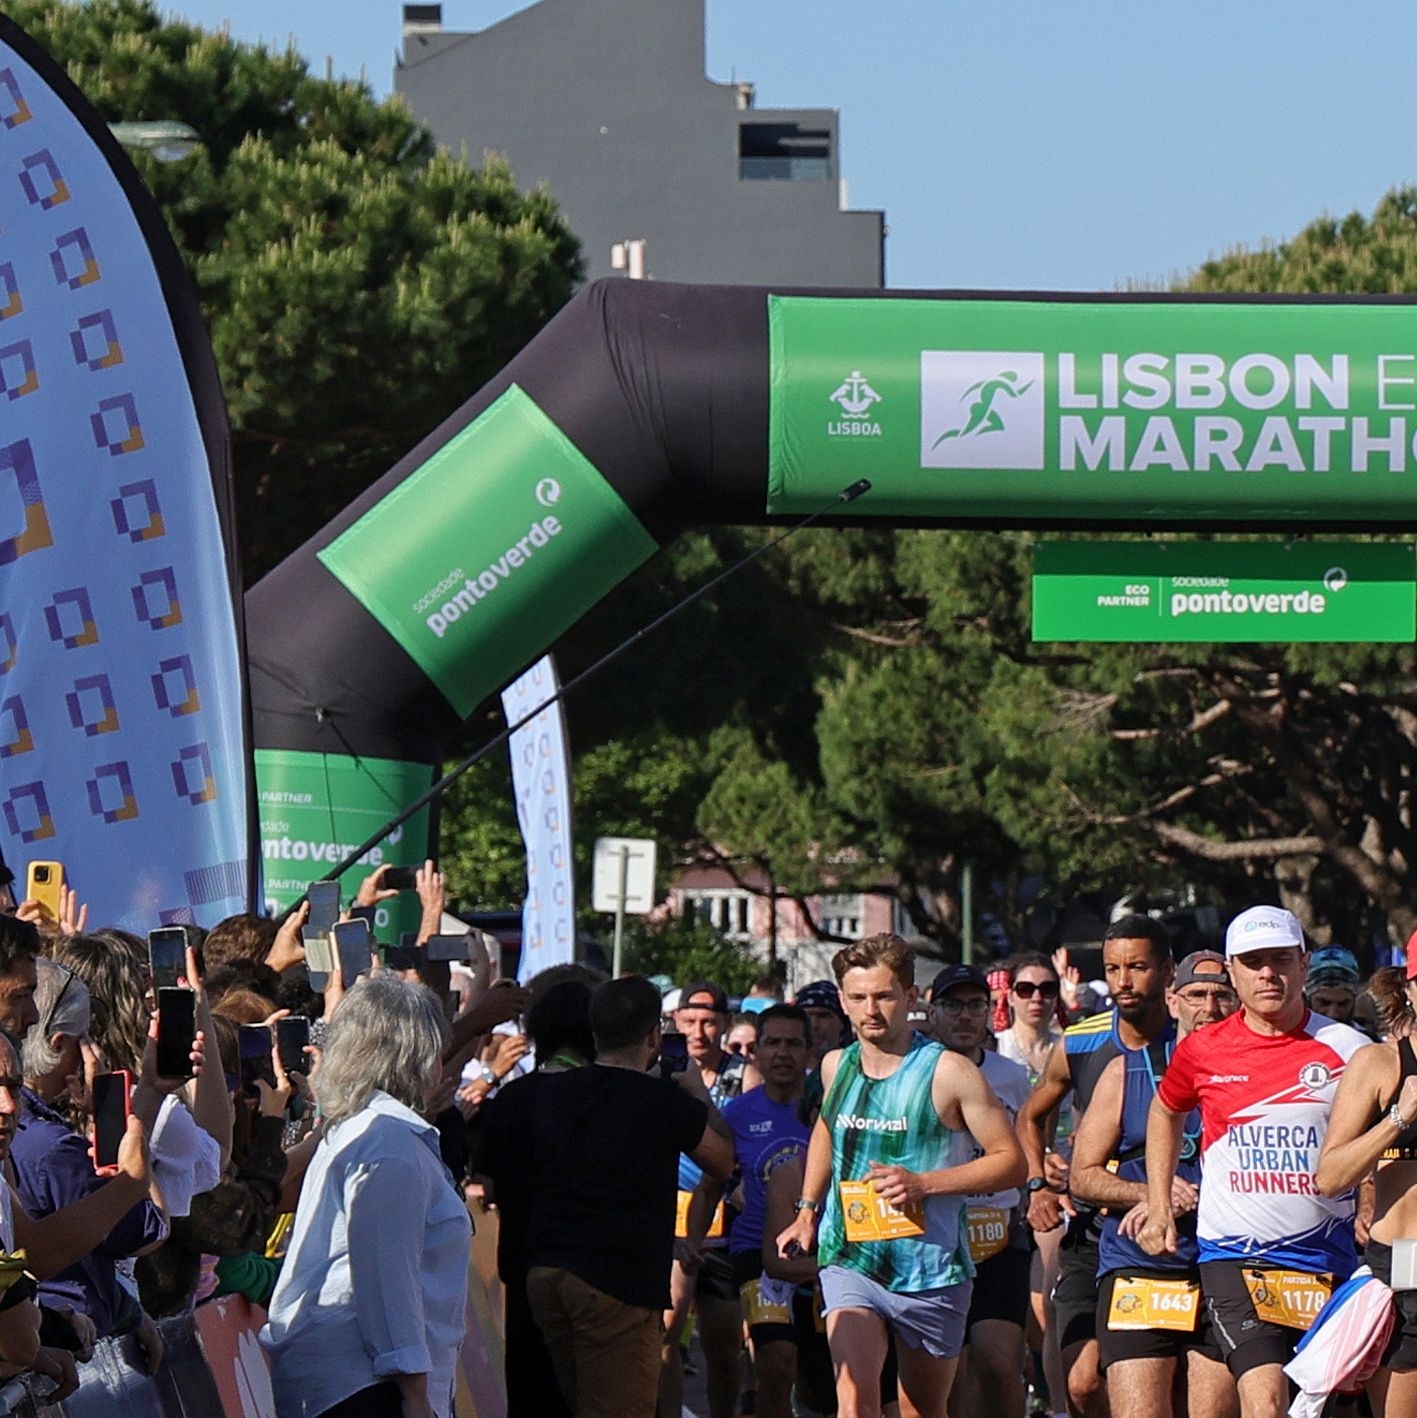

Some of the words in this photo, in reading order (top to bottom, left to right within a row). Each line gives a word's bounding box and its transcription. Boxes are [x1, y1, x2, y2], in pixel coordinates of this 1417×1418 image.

[1057, 353, 1349, 410] LISBON
[828, 421, 882, 436] LISBOA
[426, 514, 563, 638] pontoverde
[1097, 595, 1150, 607] PARTNER
[1125, 584, 1150, 595] ECO
[1171, 589, 1326, 617] pontoverde
[1258, 920, 1280, 929] edp
[1228, 1125, 1320, 1149] ALVERCA
[1238, 1149, 1310, 1172] URBAN
[1229, 1171, 1321, 1196] RUNNERS
[967, 1222, 1005, 1242] 1180
[1151, 1291, 1194, 1313] 1643
[1282, 1290, 1326, 1313] 1178
